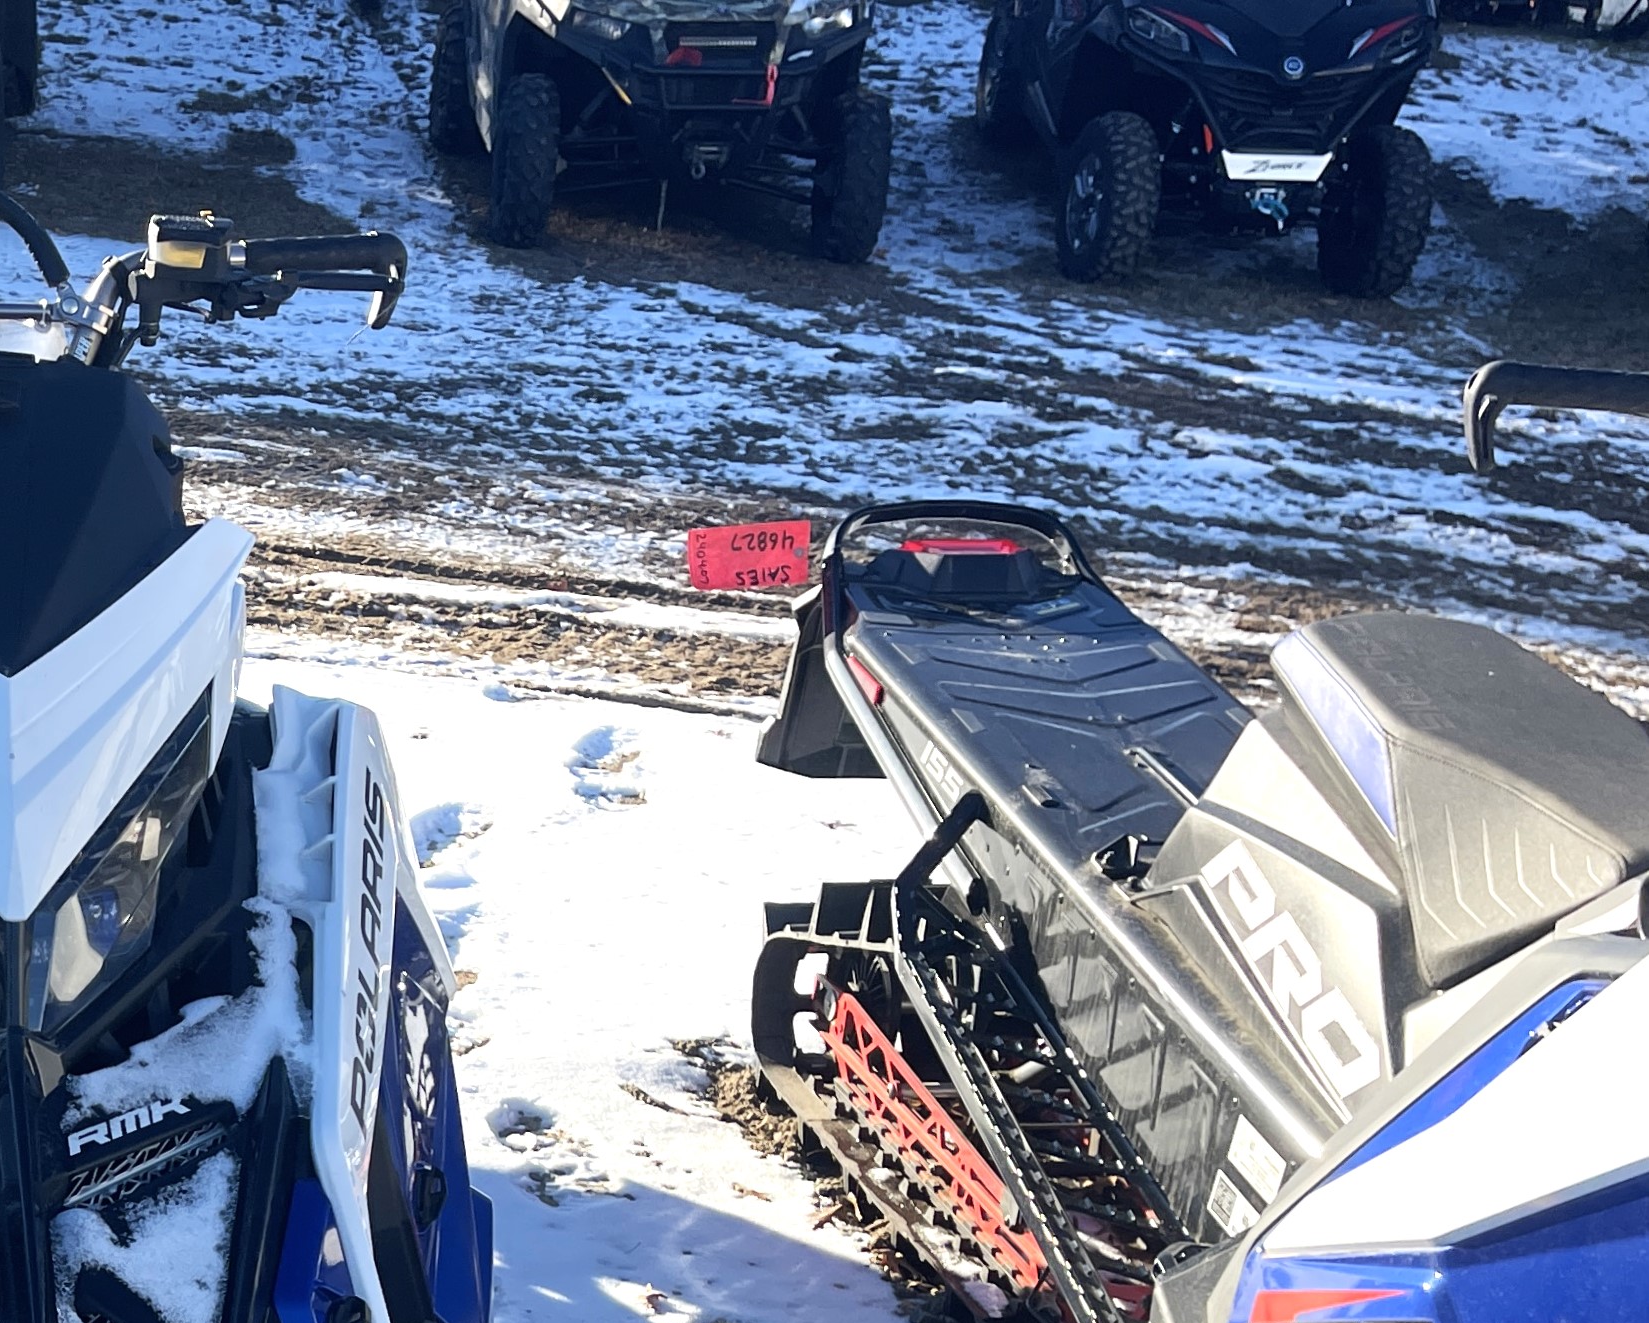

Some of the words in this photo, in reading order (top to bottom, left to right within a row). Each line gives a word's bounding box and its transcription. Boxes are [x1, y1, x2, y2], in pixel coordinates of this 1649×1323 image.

[731, 530, 795, 552] 46827
[350, 765, 385, 1142] POLARIS
[1200, 838, 1381, 1100] PRO
[67, 1097, 192, 1156] RMK
